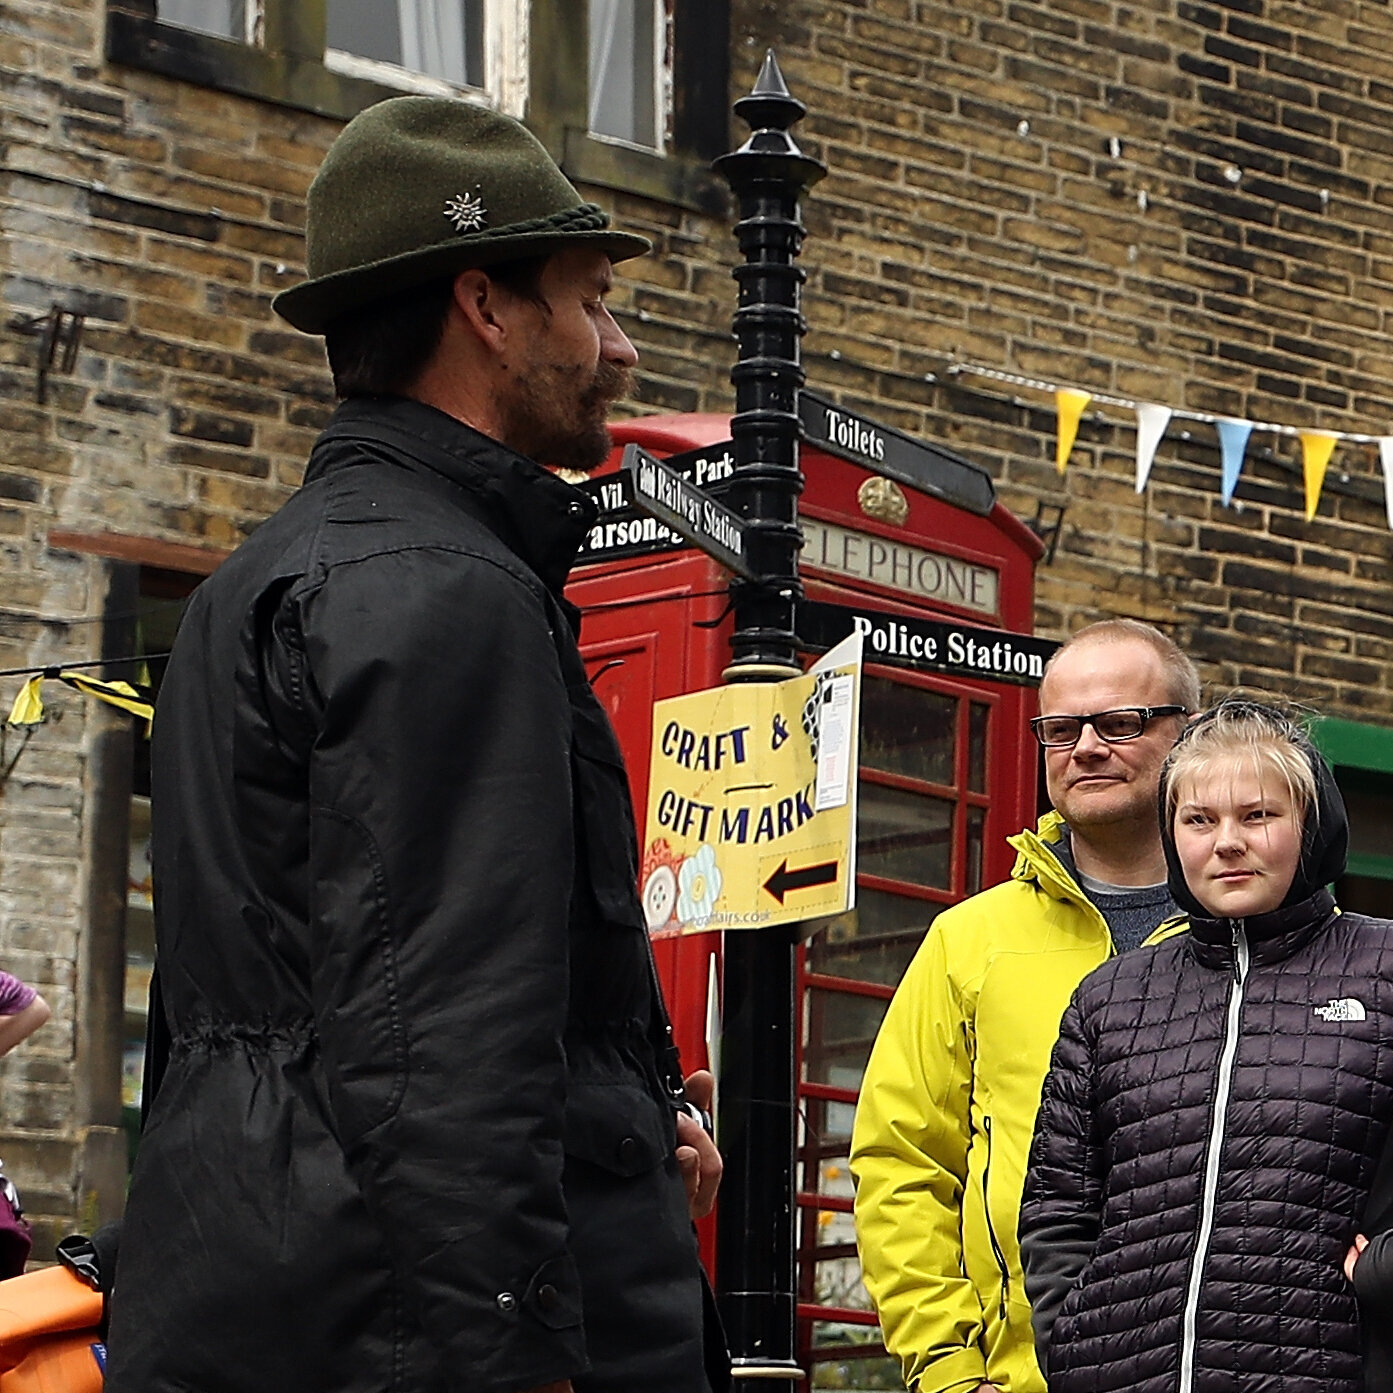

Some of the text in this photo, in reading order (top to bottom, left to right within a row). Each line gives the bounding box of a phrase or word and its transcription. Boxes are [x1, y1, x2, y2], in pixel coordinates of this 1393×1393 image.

[826, 409, 884, 461] Toilets
[695, 452, 734, 486] Park
[577, 517, 684, 552] arsona
[657, 467, 742, 555] Railway Station
[800, 518, 987, 606] ELEPHONE
[852, 616, 1043, 677] Police Station
[661, 720, 750, 772] CRAFT
[771, 713, 790, 751] &
[657, 782, 816, 844] GIFT MARK
